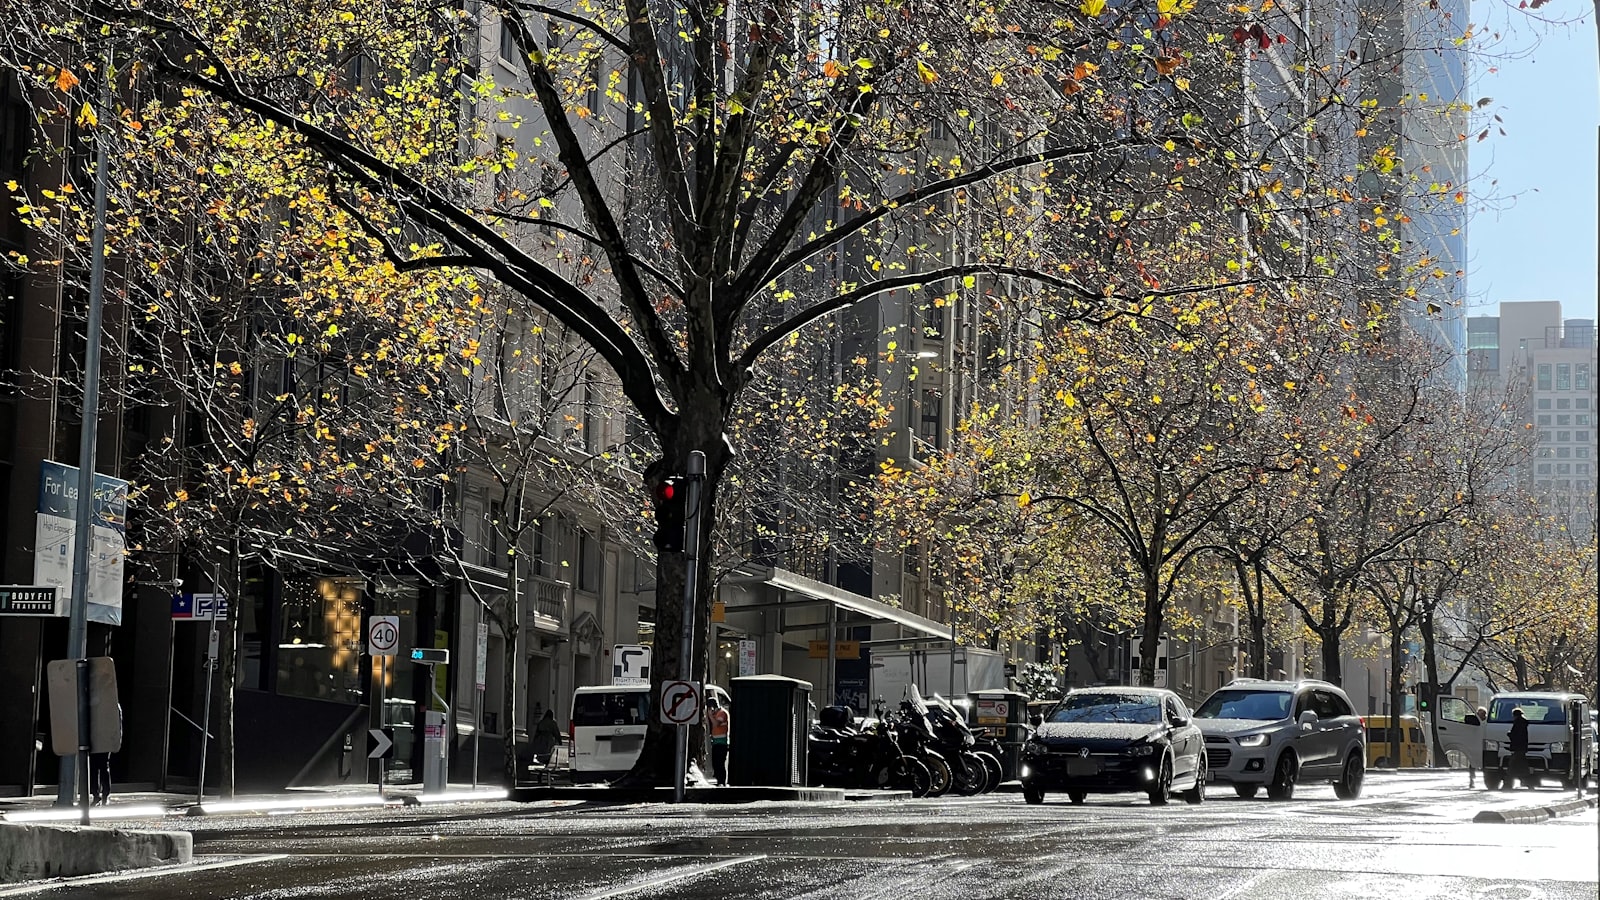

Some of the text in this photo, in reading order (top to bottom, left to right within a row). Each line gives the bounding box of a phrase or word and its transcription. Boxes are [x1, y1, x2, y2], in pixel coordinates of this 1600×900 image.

[44, 477, 79, 500] For Lea
[12, 592, 52, 600] BODY FIT
[373, 628, 394, 643] 40
